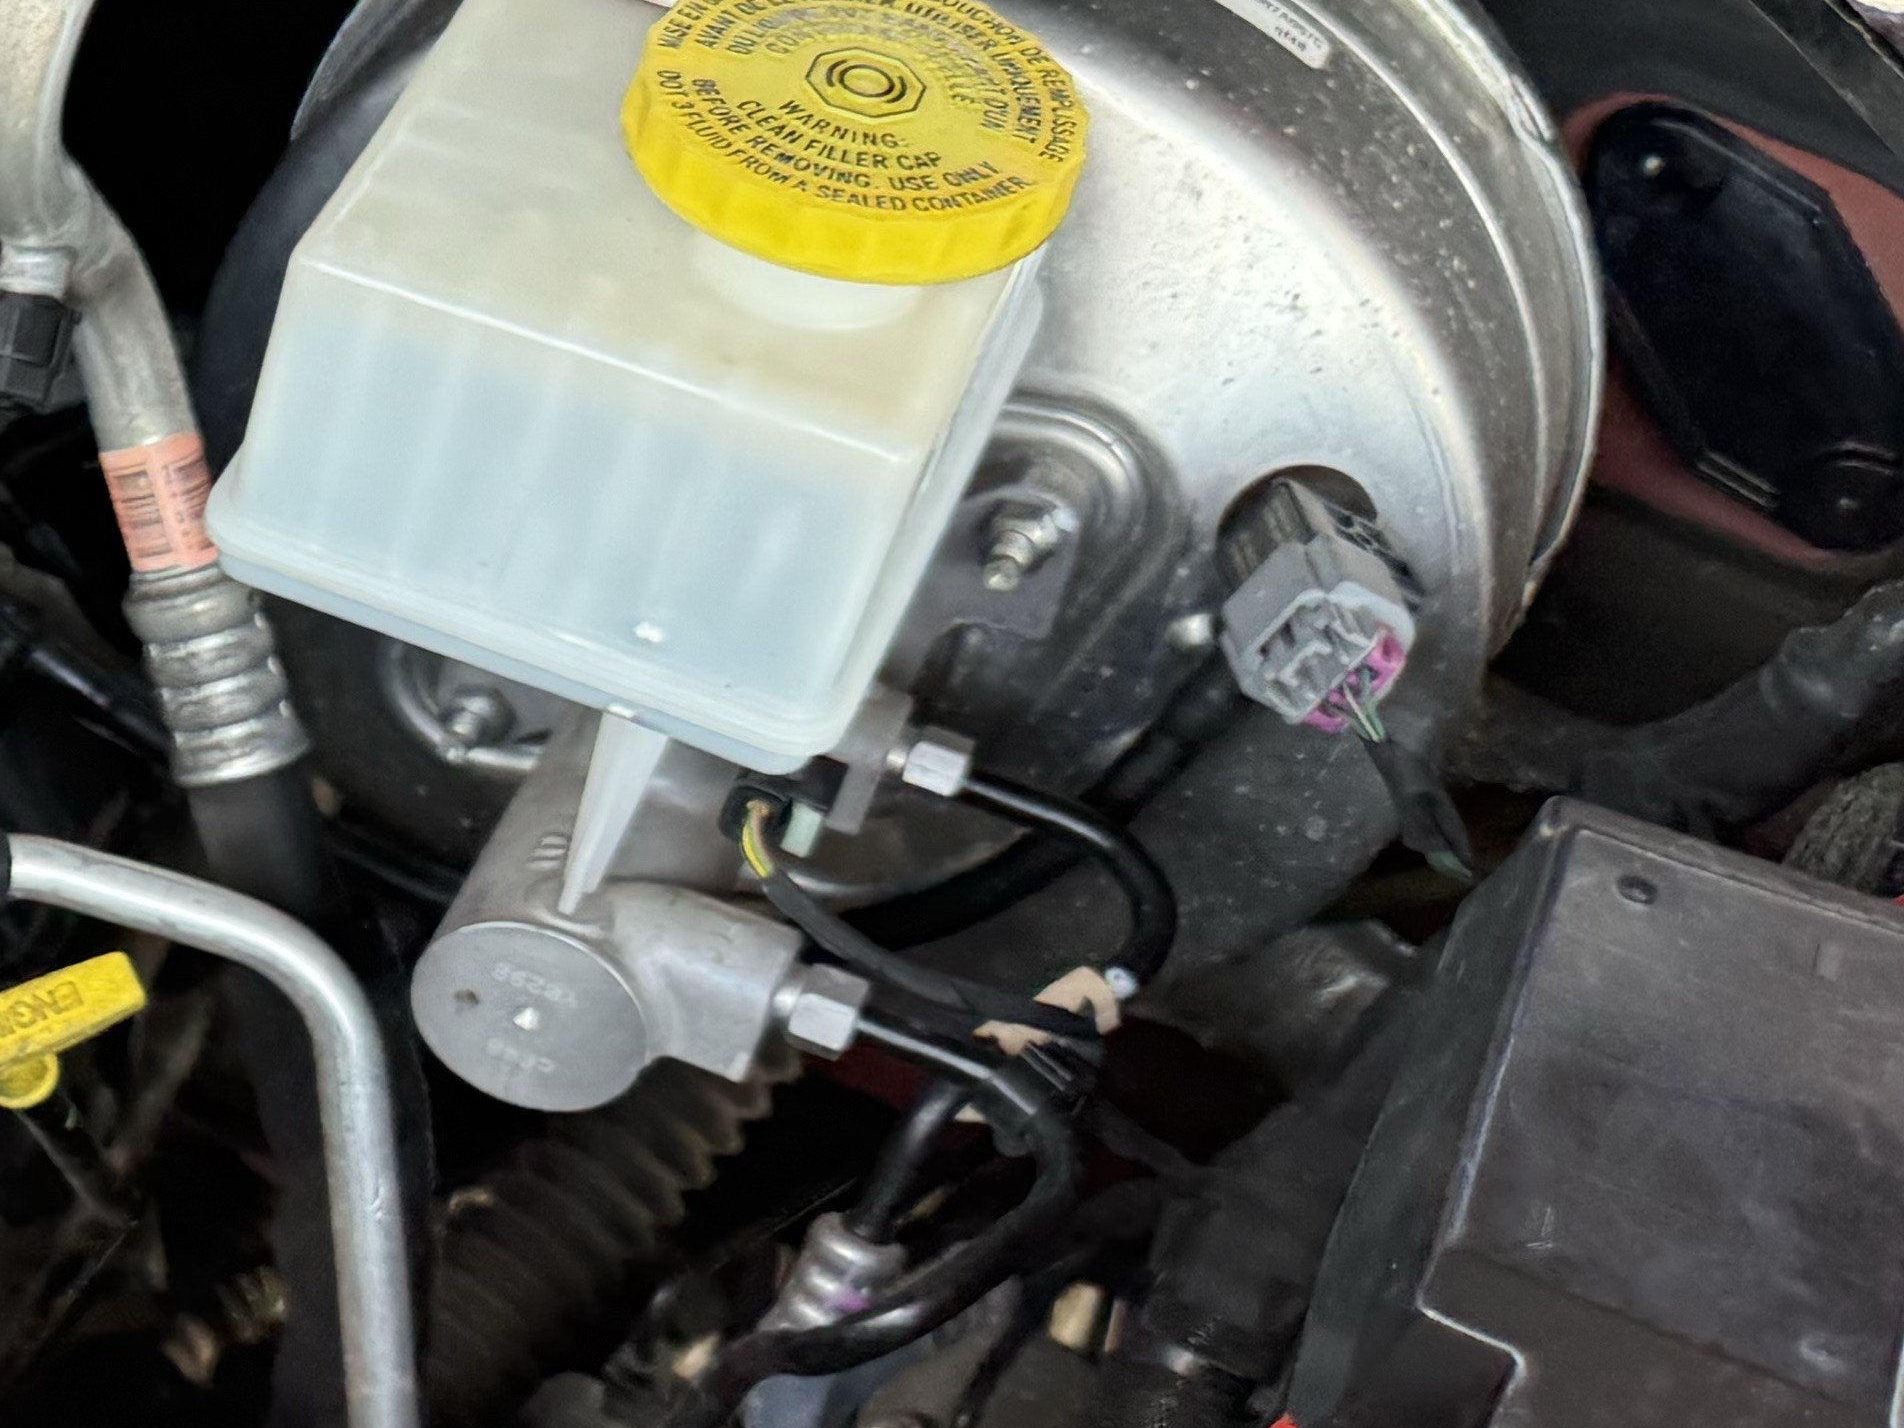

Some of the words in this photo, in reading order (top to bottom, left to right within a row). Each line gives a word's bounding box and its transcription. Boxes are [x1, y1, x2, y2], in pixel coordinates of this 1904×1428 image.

[725, 35, 757, 55] DU
[656, 20, 693, 50] MISE
[677, 1, 709, 22] EN
[1020, 46, 1050, 66] DE
[1037, 69, 1078, 164] REMPLISSAGE
[656, 69, 690, 99] DOT
[695, 9, 738, 50] AVANT
[905, 2, 998, 51] UTILISER
[992, 52, 1042, 145] UNIQUEMENT
[670, 100, 696, 110] 3
[679, 111, 733, 151] FLUID
[691, 78, 752, 135] BEFORE
[889, 174, 940, 192] USE
[942, 160, 1001, 188] ONLY
[735, 99, 805, 144] CLEAN
[802, 138, 889, 170] FILLER
[896, 151, 942, 171] CAP
[723, 148, 792, 185] FROM
[790, 178, 809, 193] A
[815, 184, 908, 212] SEALED
